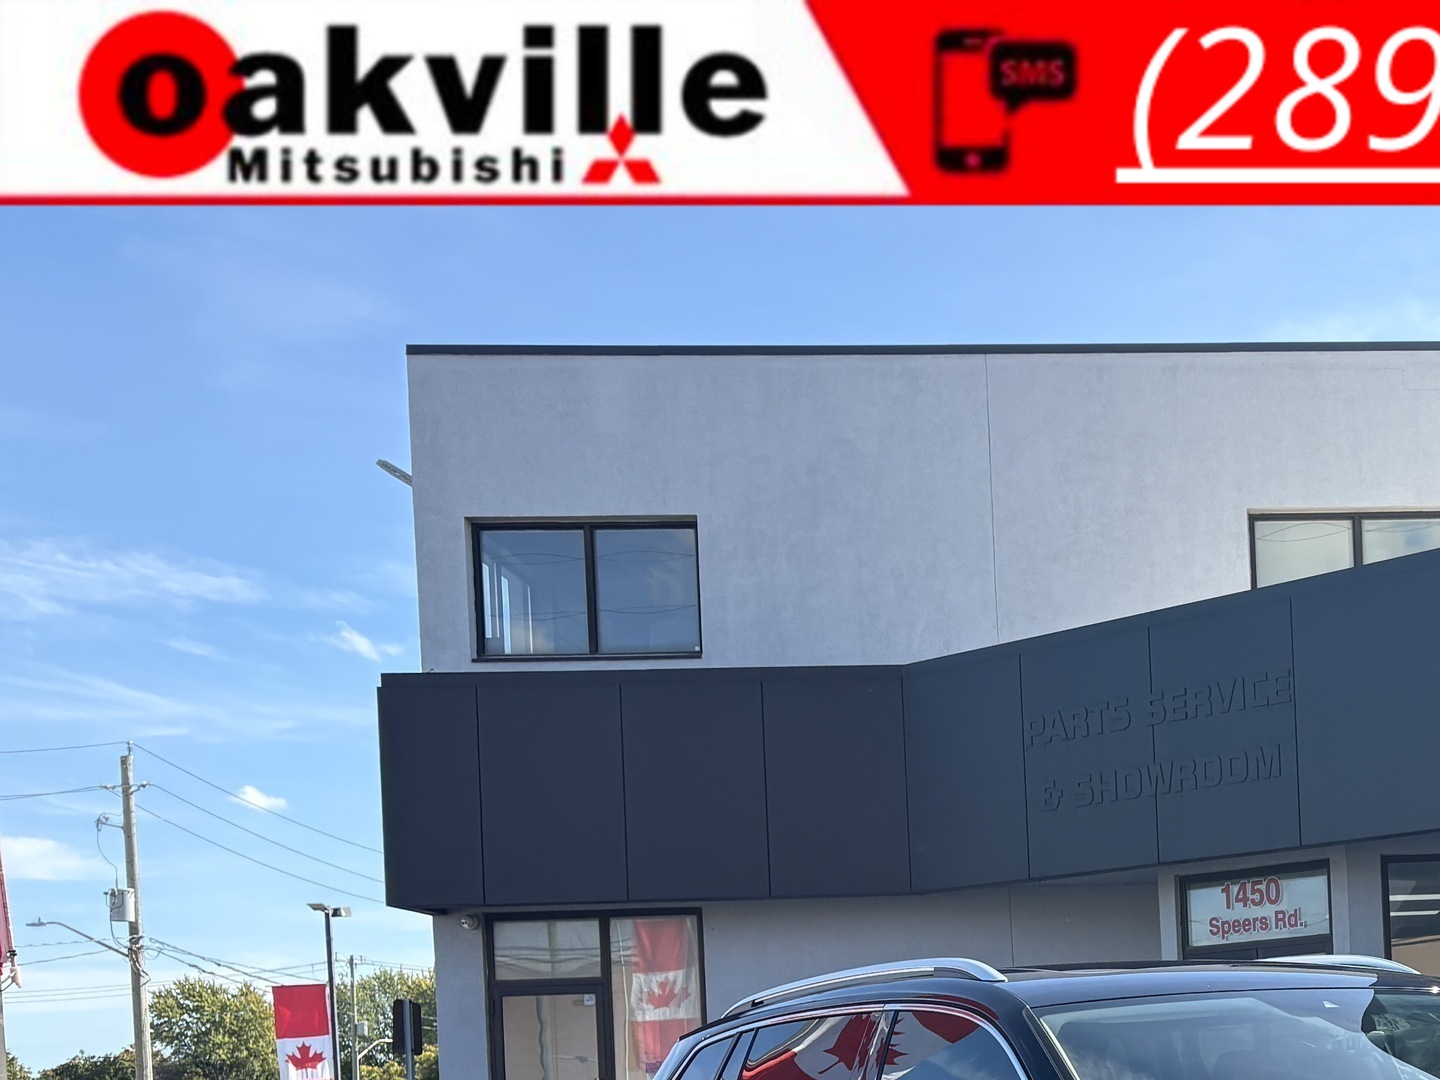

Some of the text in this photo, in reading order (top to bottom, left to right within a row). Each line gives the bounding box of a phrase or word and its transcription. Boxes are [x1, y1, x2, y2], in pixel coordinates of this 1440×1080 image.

[1025, 668, 1293, 748] PARTS SERVICE
[1074, 743, 1282, 809] SHOWROOM
[1220, 877, 1281, 911] 1450
[1208, 908, 1304, 940] Speers Rd.
